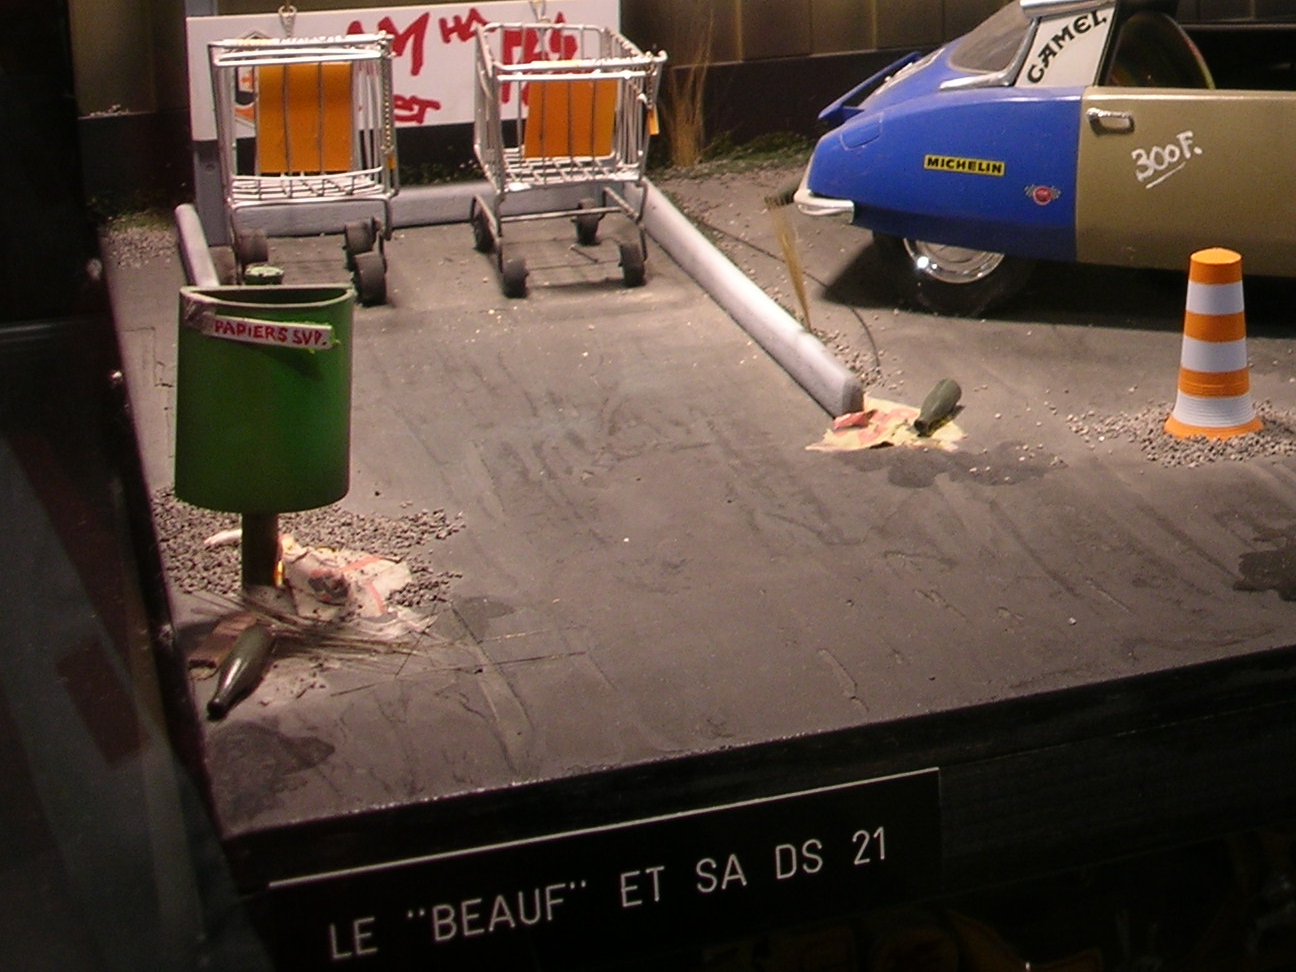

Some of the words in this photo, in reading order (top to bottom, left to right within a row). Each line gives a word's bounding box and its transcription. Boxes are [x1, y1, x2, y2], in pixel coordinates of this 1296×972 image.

[1026, 8, 1108, 84] CAMEL
[926, 157, 1003, 174] MICHELIN
[214, 319, 288, 343] PAPIERS
[329, 916, 378, 960] LE
[620, 865, 665, 908] ET
[696, 853, 747, 894] SA
[775, 839, 824, 880] DS
[852, 826, 886, 866] 21
